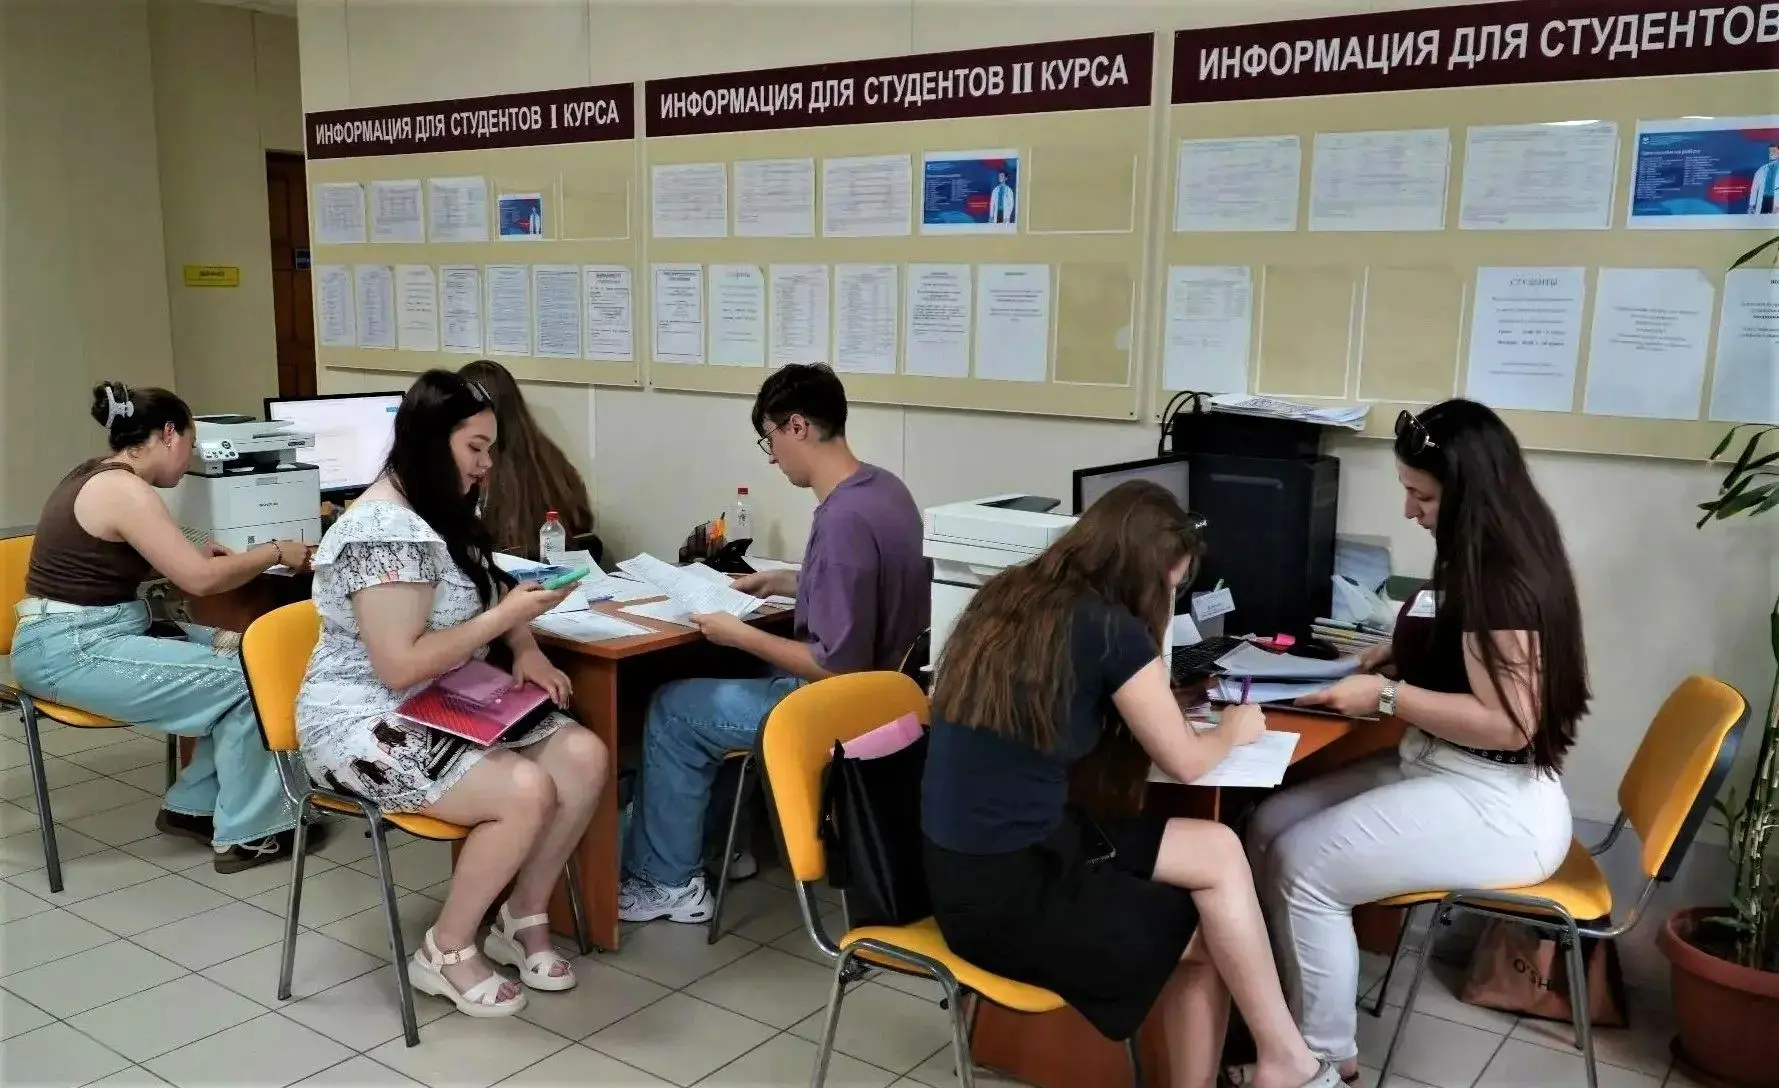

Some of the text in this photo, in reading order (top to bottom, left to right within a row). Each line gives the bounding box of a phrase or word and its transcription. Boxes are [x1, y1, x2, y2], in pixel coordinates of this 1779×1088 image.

[1199, 3, 1779, 81] ИНФОРМАЦИЯ ДЛЯ СТУДЕНТОВ
[660, 54, 1129, 119] ИНФОРМАЦИЯ ДЛЯ СТУДЕНТОВ II КУРСА
[315, 116, 412, 145] ИНФОРМАЦИЯ
[415, 114, 446, 143] ДЛЯ
[450, 105, 542, 138] СТУДЕНТОВ
[563, 99, 620, 127] КУРСА
